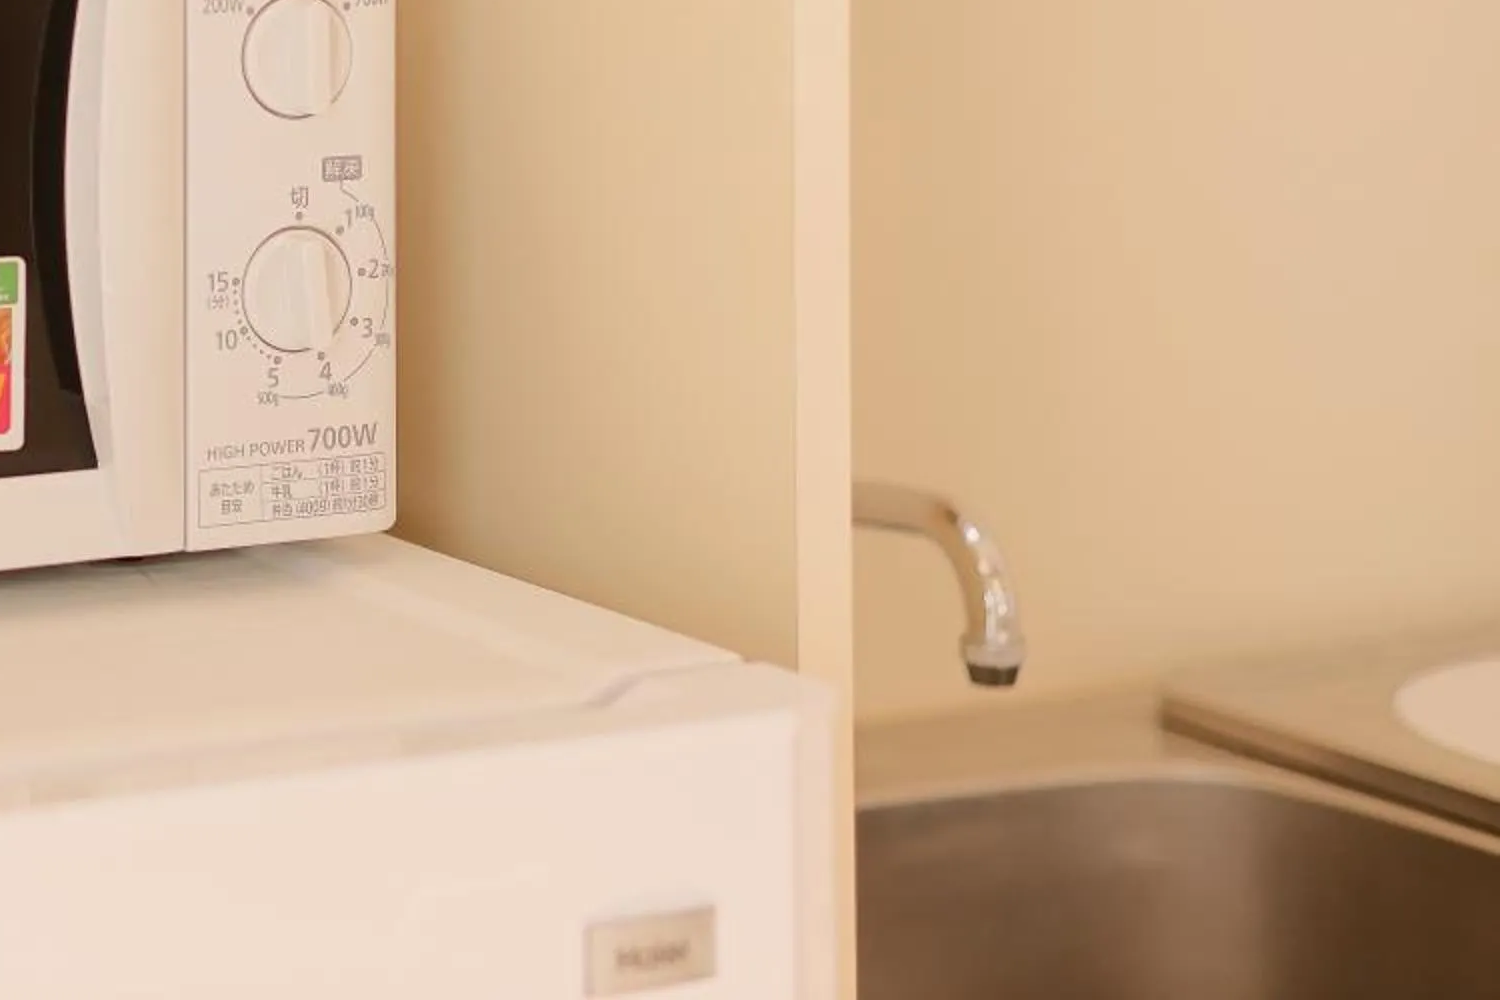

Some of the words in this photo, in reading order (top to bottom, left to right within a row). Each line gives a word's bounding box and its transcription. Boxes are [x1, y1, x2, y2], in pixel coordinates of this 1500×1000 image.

[290, 185, 309, 208] 切
[367, 259, 379, 279] 2
[207, 271, 229, 293] 15
[361, 317, 373, 339] 3
[216, 328, 238, 351] 10
[267, 367, 279, 388] 5
[319, 361, 332, 381] 4
[207, 444, 245, 462] HIGH
[250, 439, 305, 458] POWER
[307, 422, 378, 453] 700W
